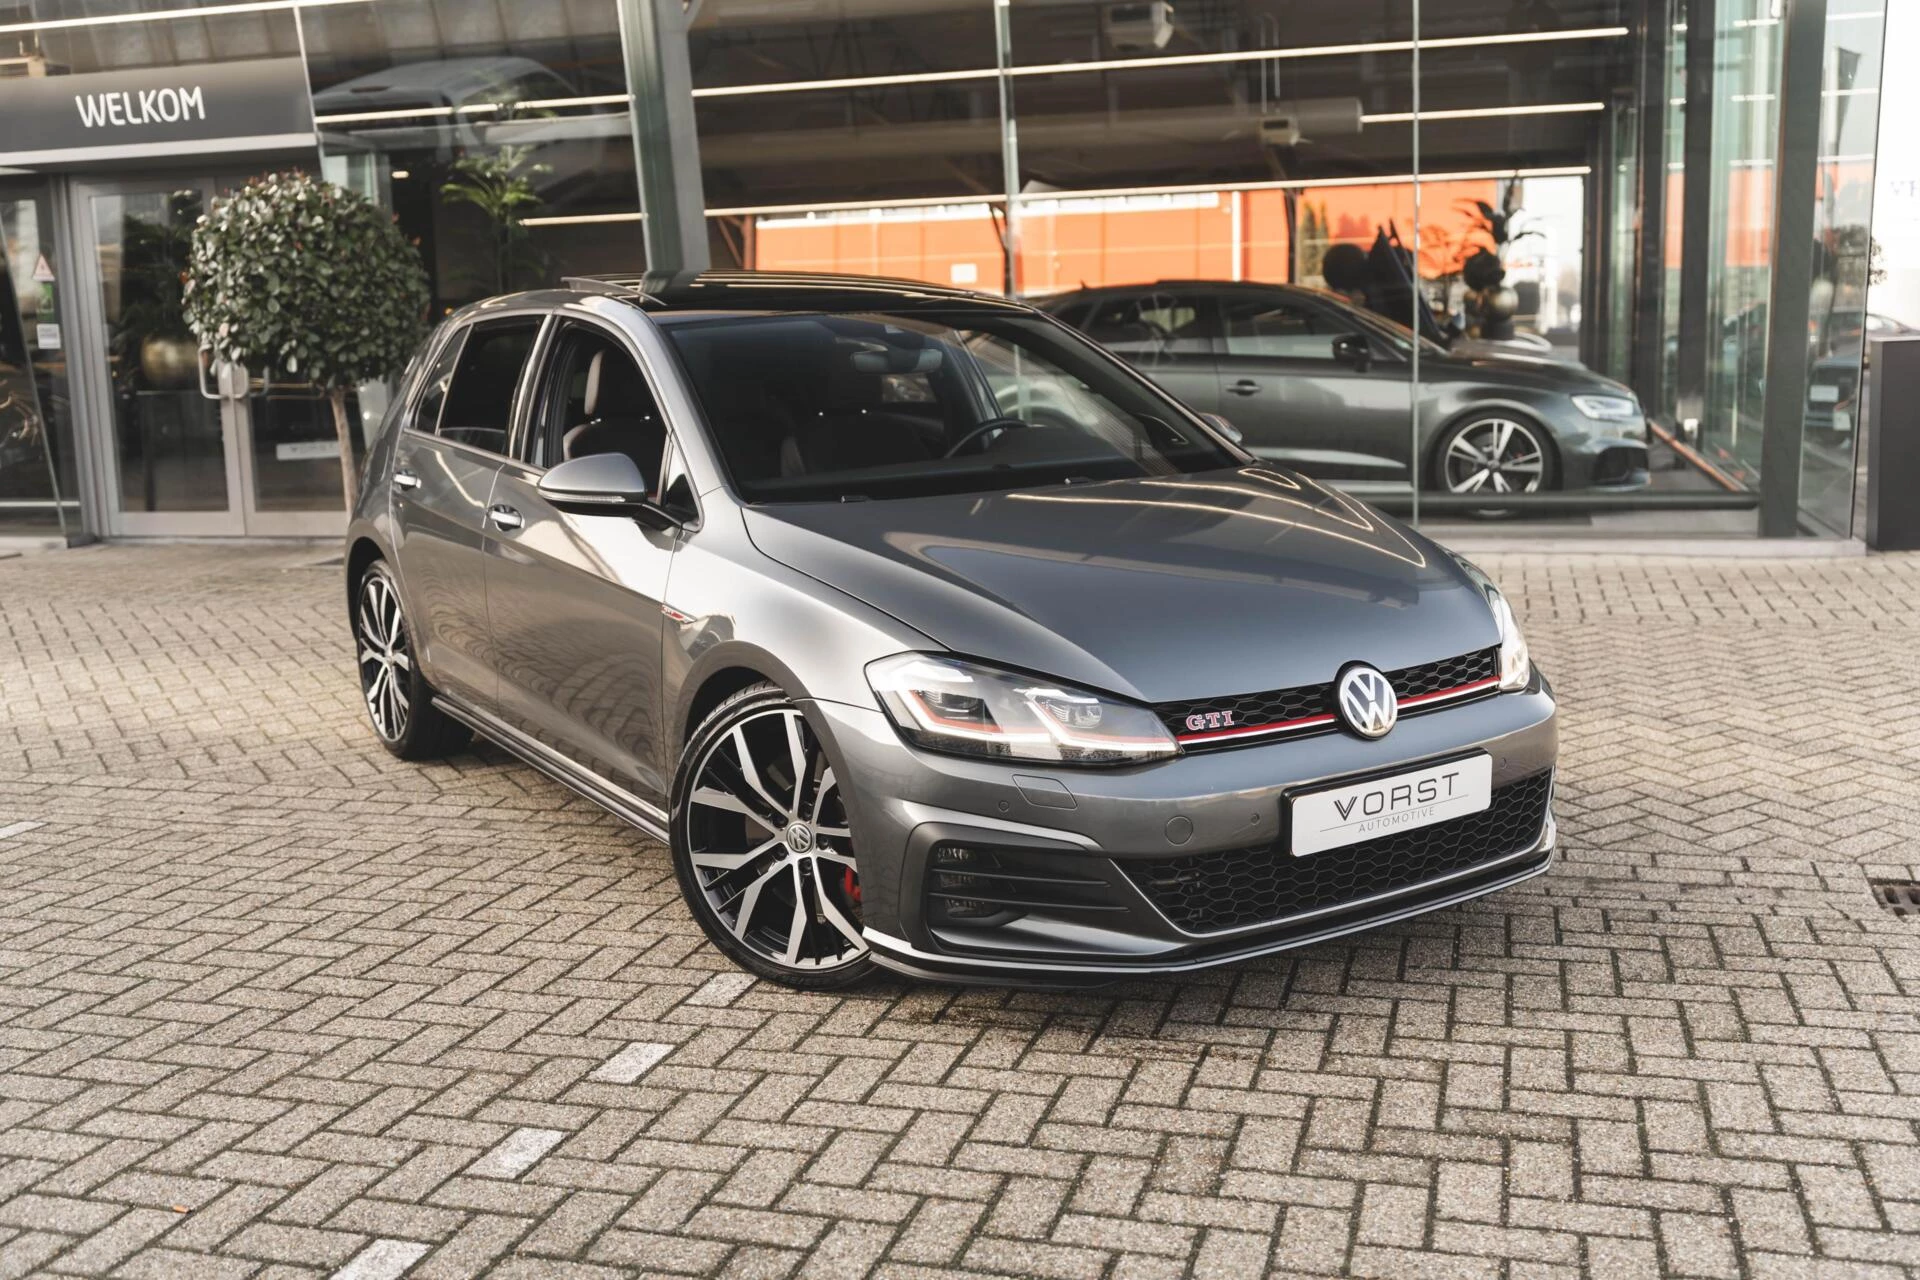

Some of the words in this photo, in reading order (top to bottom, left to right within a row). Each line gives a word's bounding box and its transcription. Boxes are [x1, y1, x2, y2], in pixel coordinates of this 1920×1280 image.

[75, 86, 205, 127] WELKOM
[1186, 711, 1234, 731] GTI
[1334, 772, 1459, 821] VORST
[1358, 807, 1435, 833] AUTOMOTIVE
